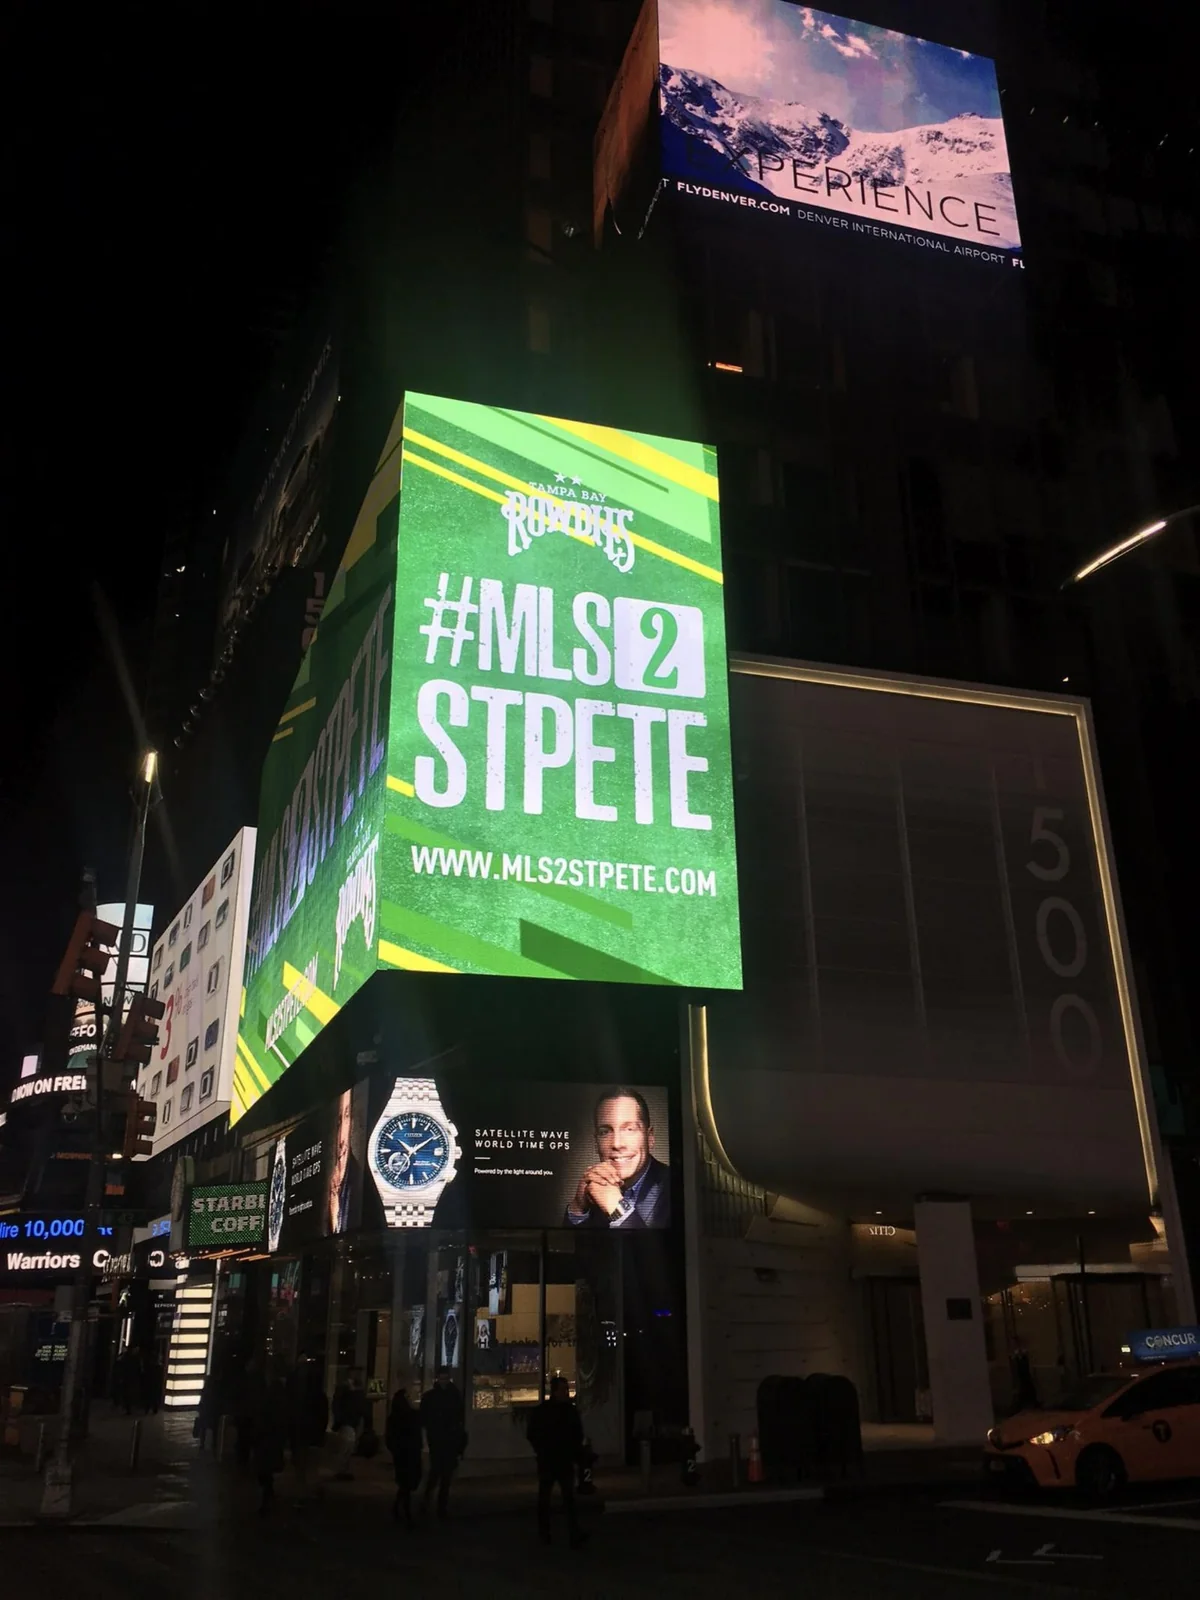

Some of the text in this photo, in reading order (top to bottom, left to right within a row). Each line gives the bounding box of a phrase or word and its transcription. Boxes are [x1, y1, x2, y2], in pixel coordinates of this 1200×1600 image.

[677, 181, 790, 216] FLYDENVER.COM
[797, 208, 849, 230] DENVER
[852, 221, 950, 253] INTERNATIONAL
[954, 245, 1006, 265] AIRPORT
[529, 481, 607, 503] TAMPA BAY
[501, 490, 636, 573] ROWDIES
[414, 678, 713, 831] STPETE
[411, 845, 717, 897] WWW.MLS2STPETE.COM
[34, 1077, 53, 1095] ON
[475, 1128, 570, 1140] SATELLITE WAVE
[474, 1140, 570, 1150] WORLD TIME GPS
[474, 1167, 496, 1175] Powered
[497, 1168, 504, 1176] by
[513, 1168, 525, 1176] light
[24, 1218, 85, 1240] 10,000
[211, 1215, 265, 1233] COFF
[7, 1250, 81, 1270] Warriors
[1145, 1332, 1197, 1349] CONCUR
